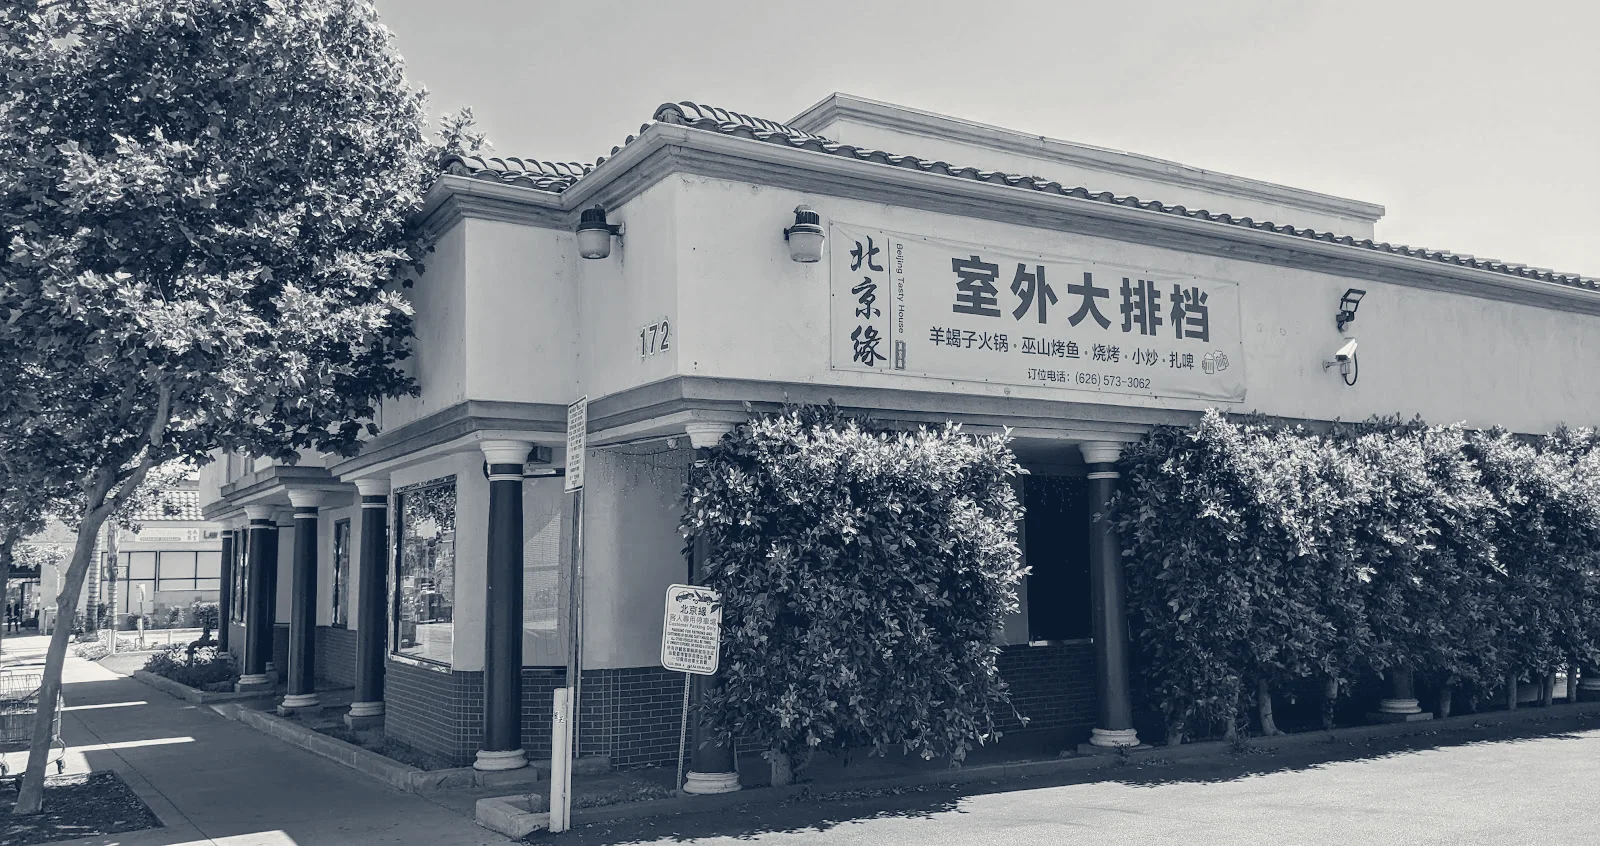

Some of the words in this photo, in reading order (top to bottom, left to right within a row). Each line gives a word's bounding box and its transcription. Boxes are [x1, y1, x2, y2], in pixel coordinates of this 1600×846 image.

[896, 243, 904, 274] Beijing
[896, 276, 905, 304] Tasty
[951, 255, 1210, 343] 室外大排档
[898, 304, 906, 334] House
[639, 319, 670, 357] 172
[929, 326, 1009, 353] 羊蝎子火锅
[1021, 336, 1080, 359] 巫山烤鱼
[1092, 343, 1121, 363] 烧烤
[1131, 347, 1159, 366] 小炒
[1169, 351, 1195, 370] 扎啤
[1075, 371, 1101, 386] (626)
[1103, 375, 1151, 389] 573-3062
